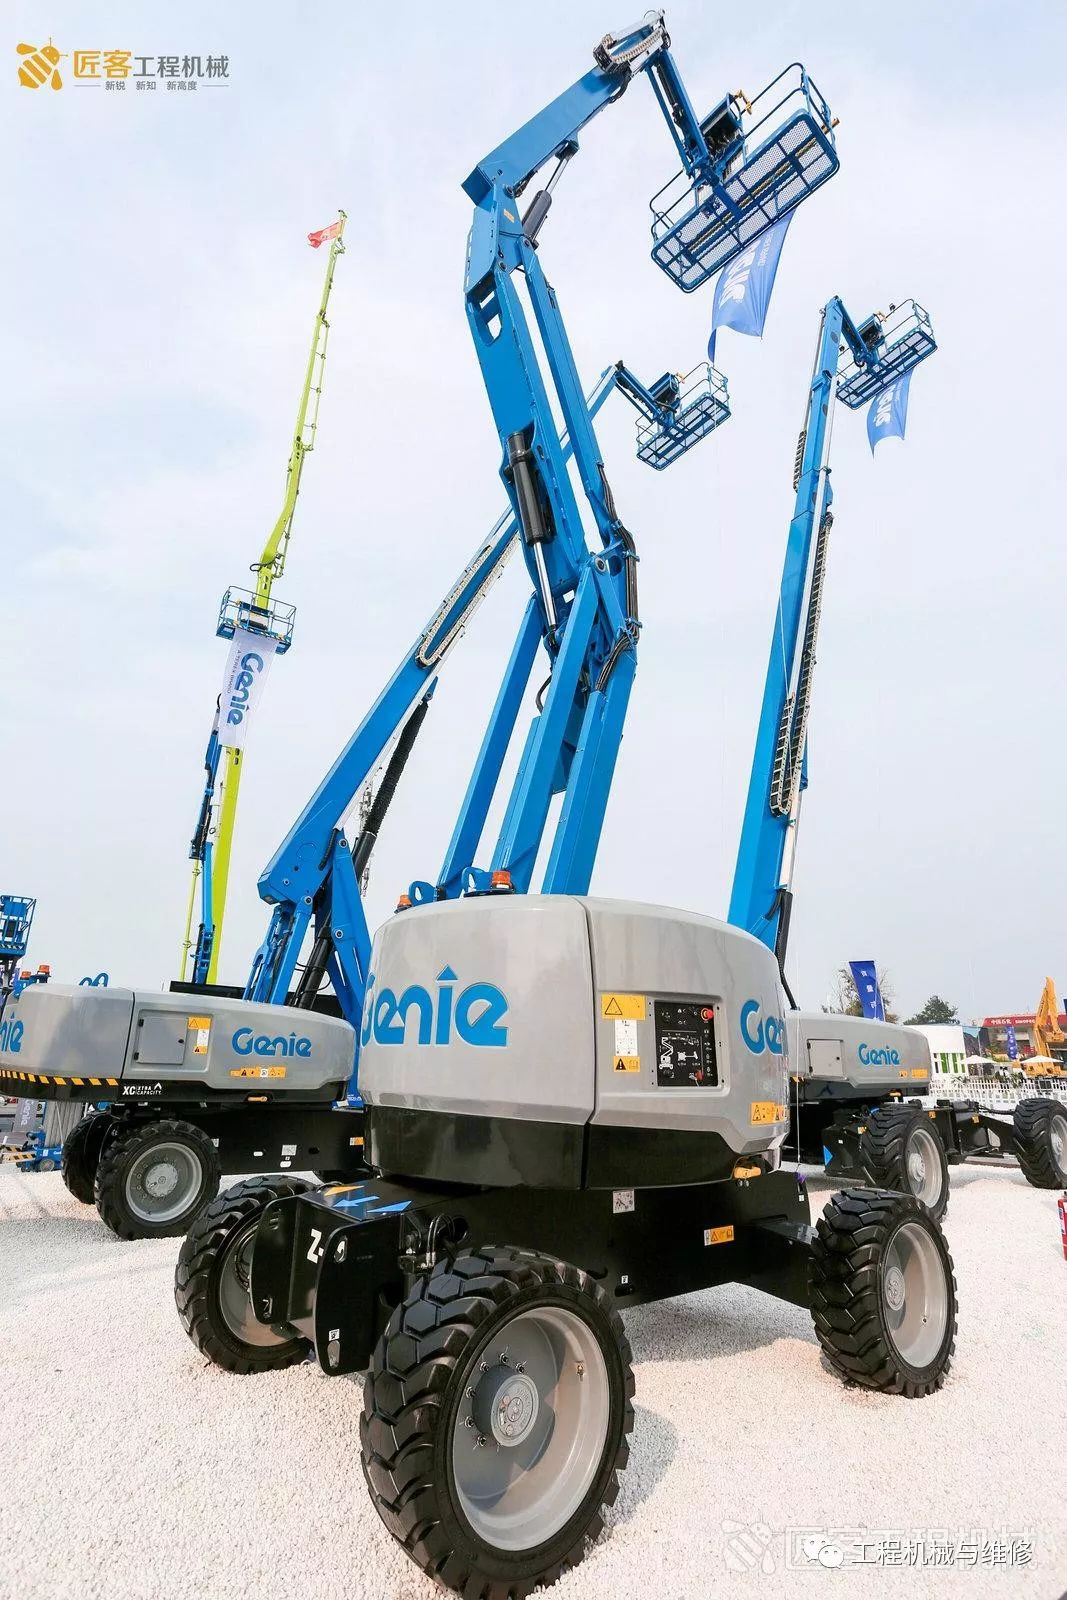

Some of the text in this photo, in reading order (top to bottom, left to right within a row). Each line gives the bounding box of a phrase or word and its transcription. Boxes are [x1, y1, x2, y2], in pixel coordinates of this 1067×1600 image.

[226, 652, 264, 726] Genie
[232, 1027, 312, 1057] Genie
[858, 1043, 900, 1065] Genie
[122, 1085, 136, 1096] XC
